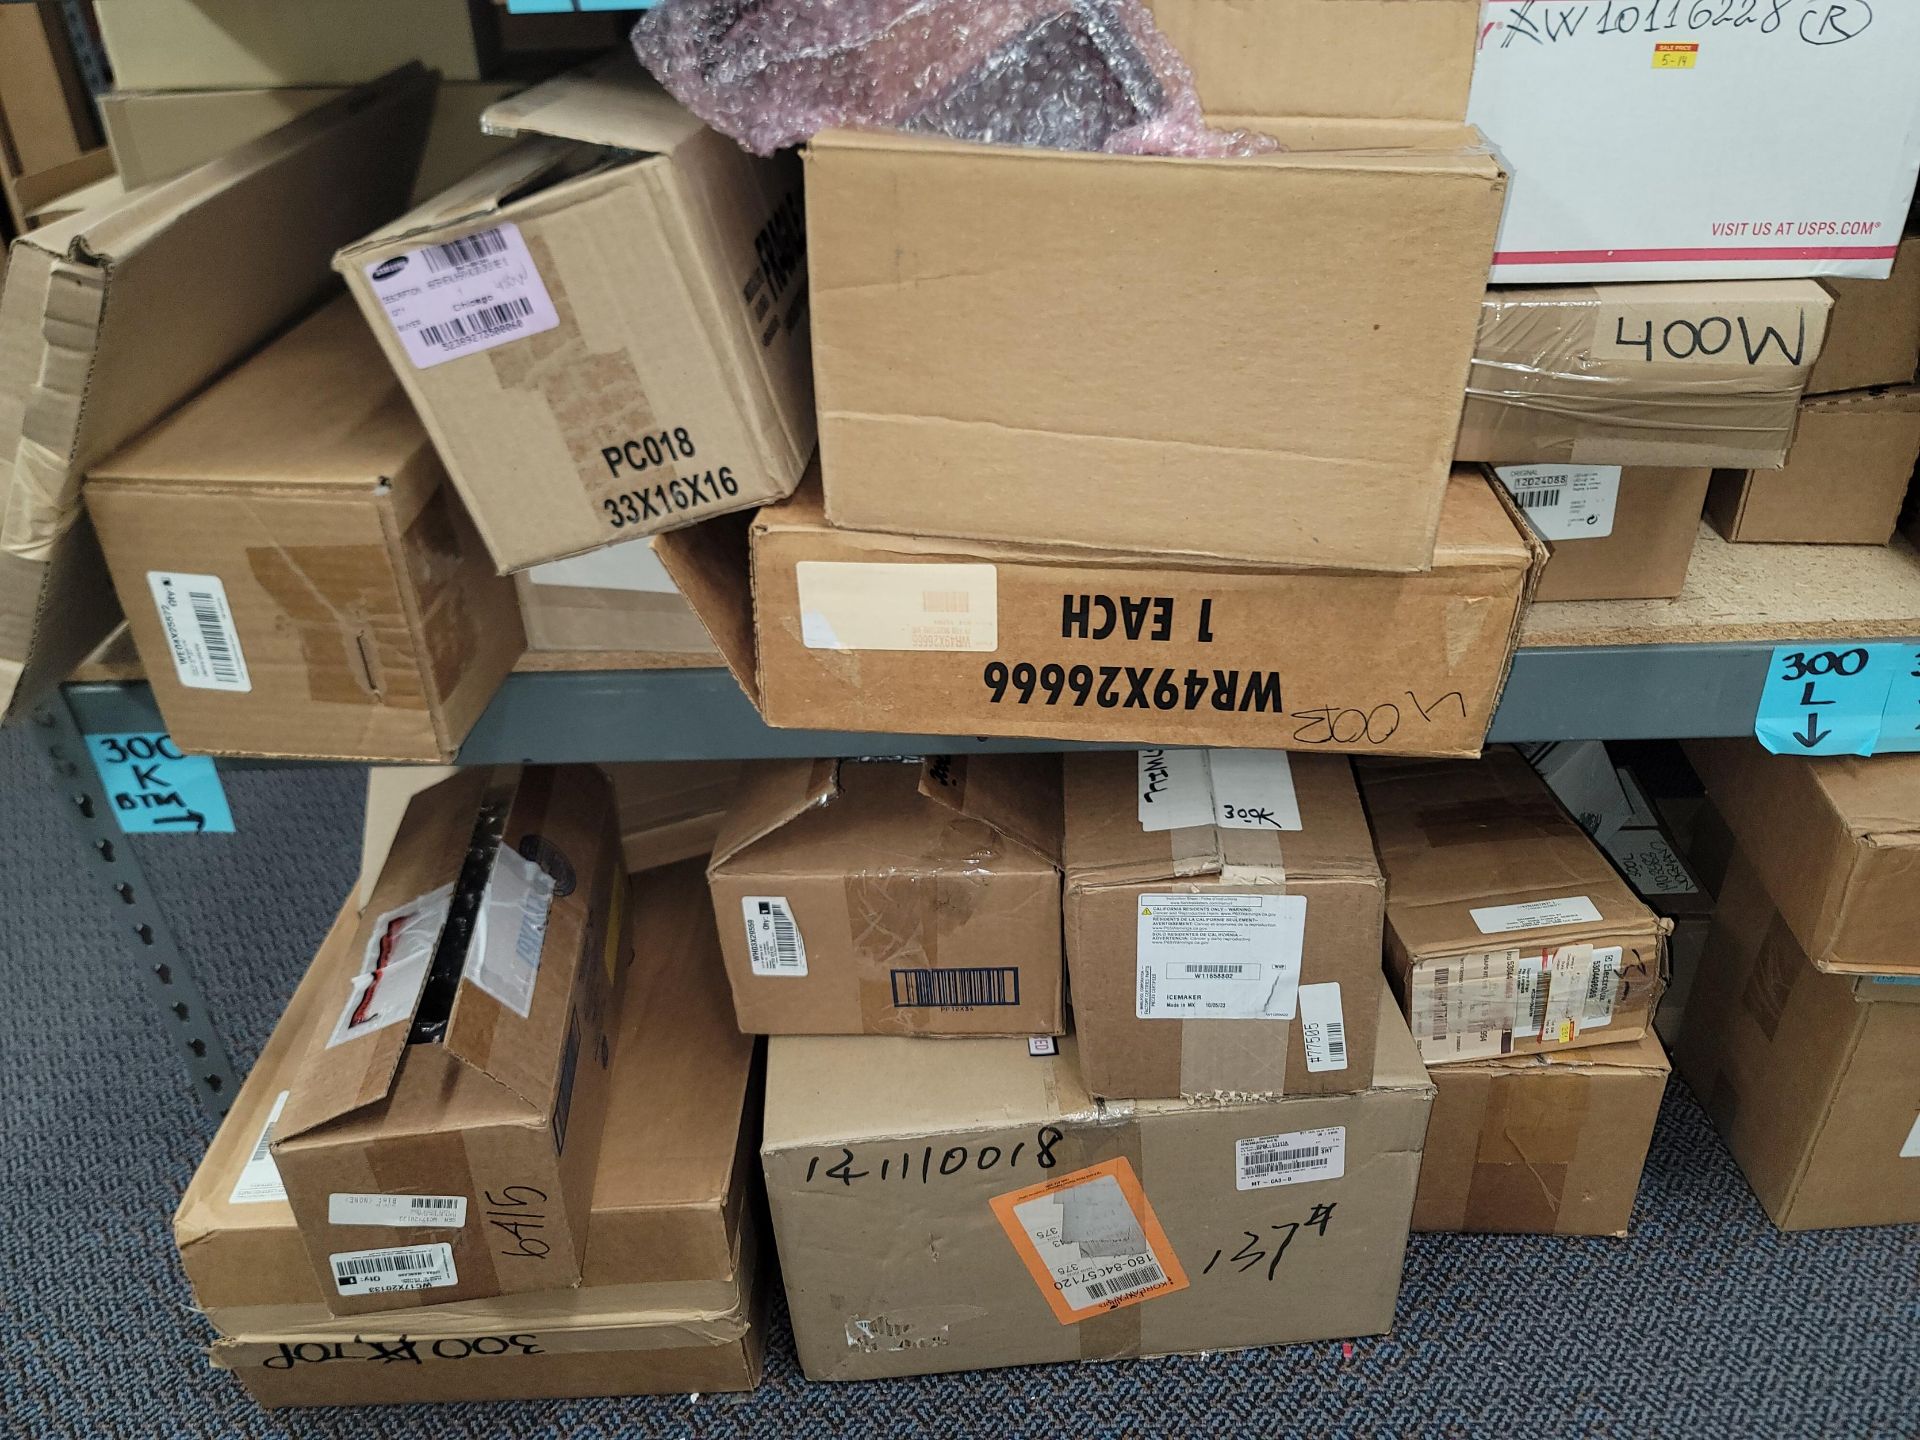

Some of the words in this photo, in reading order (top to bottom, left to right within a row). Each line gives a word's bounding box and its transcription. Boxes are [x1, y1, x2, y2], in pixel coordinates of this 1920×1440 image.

[1711, 222, 1749, 237] VISIT
[1752, 222, 1773, 236] US
[1775, 221, 1795, 236] AT
[452, 295, 494, 312] Chicago
[1616, 307, 1805, 365] 400W
[601, 427, 696, 479] PC018
[603, 466, 739, 528] 33X16X16
[1062, 594, 1174, 642] EACH
[1198, 598, 1214, 643] 1
[1781, 647, 1870, 681] 300
[984, 661, 1283, 713] WR49X26666
[1799, 681, 1837, 706] L
[131, 764, 172, 790] K
[115, 791, 187, 810] BTM
[1223, 804, 1282, 829] 300K
[431, 1333, 547, 1360] 300
